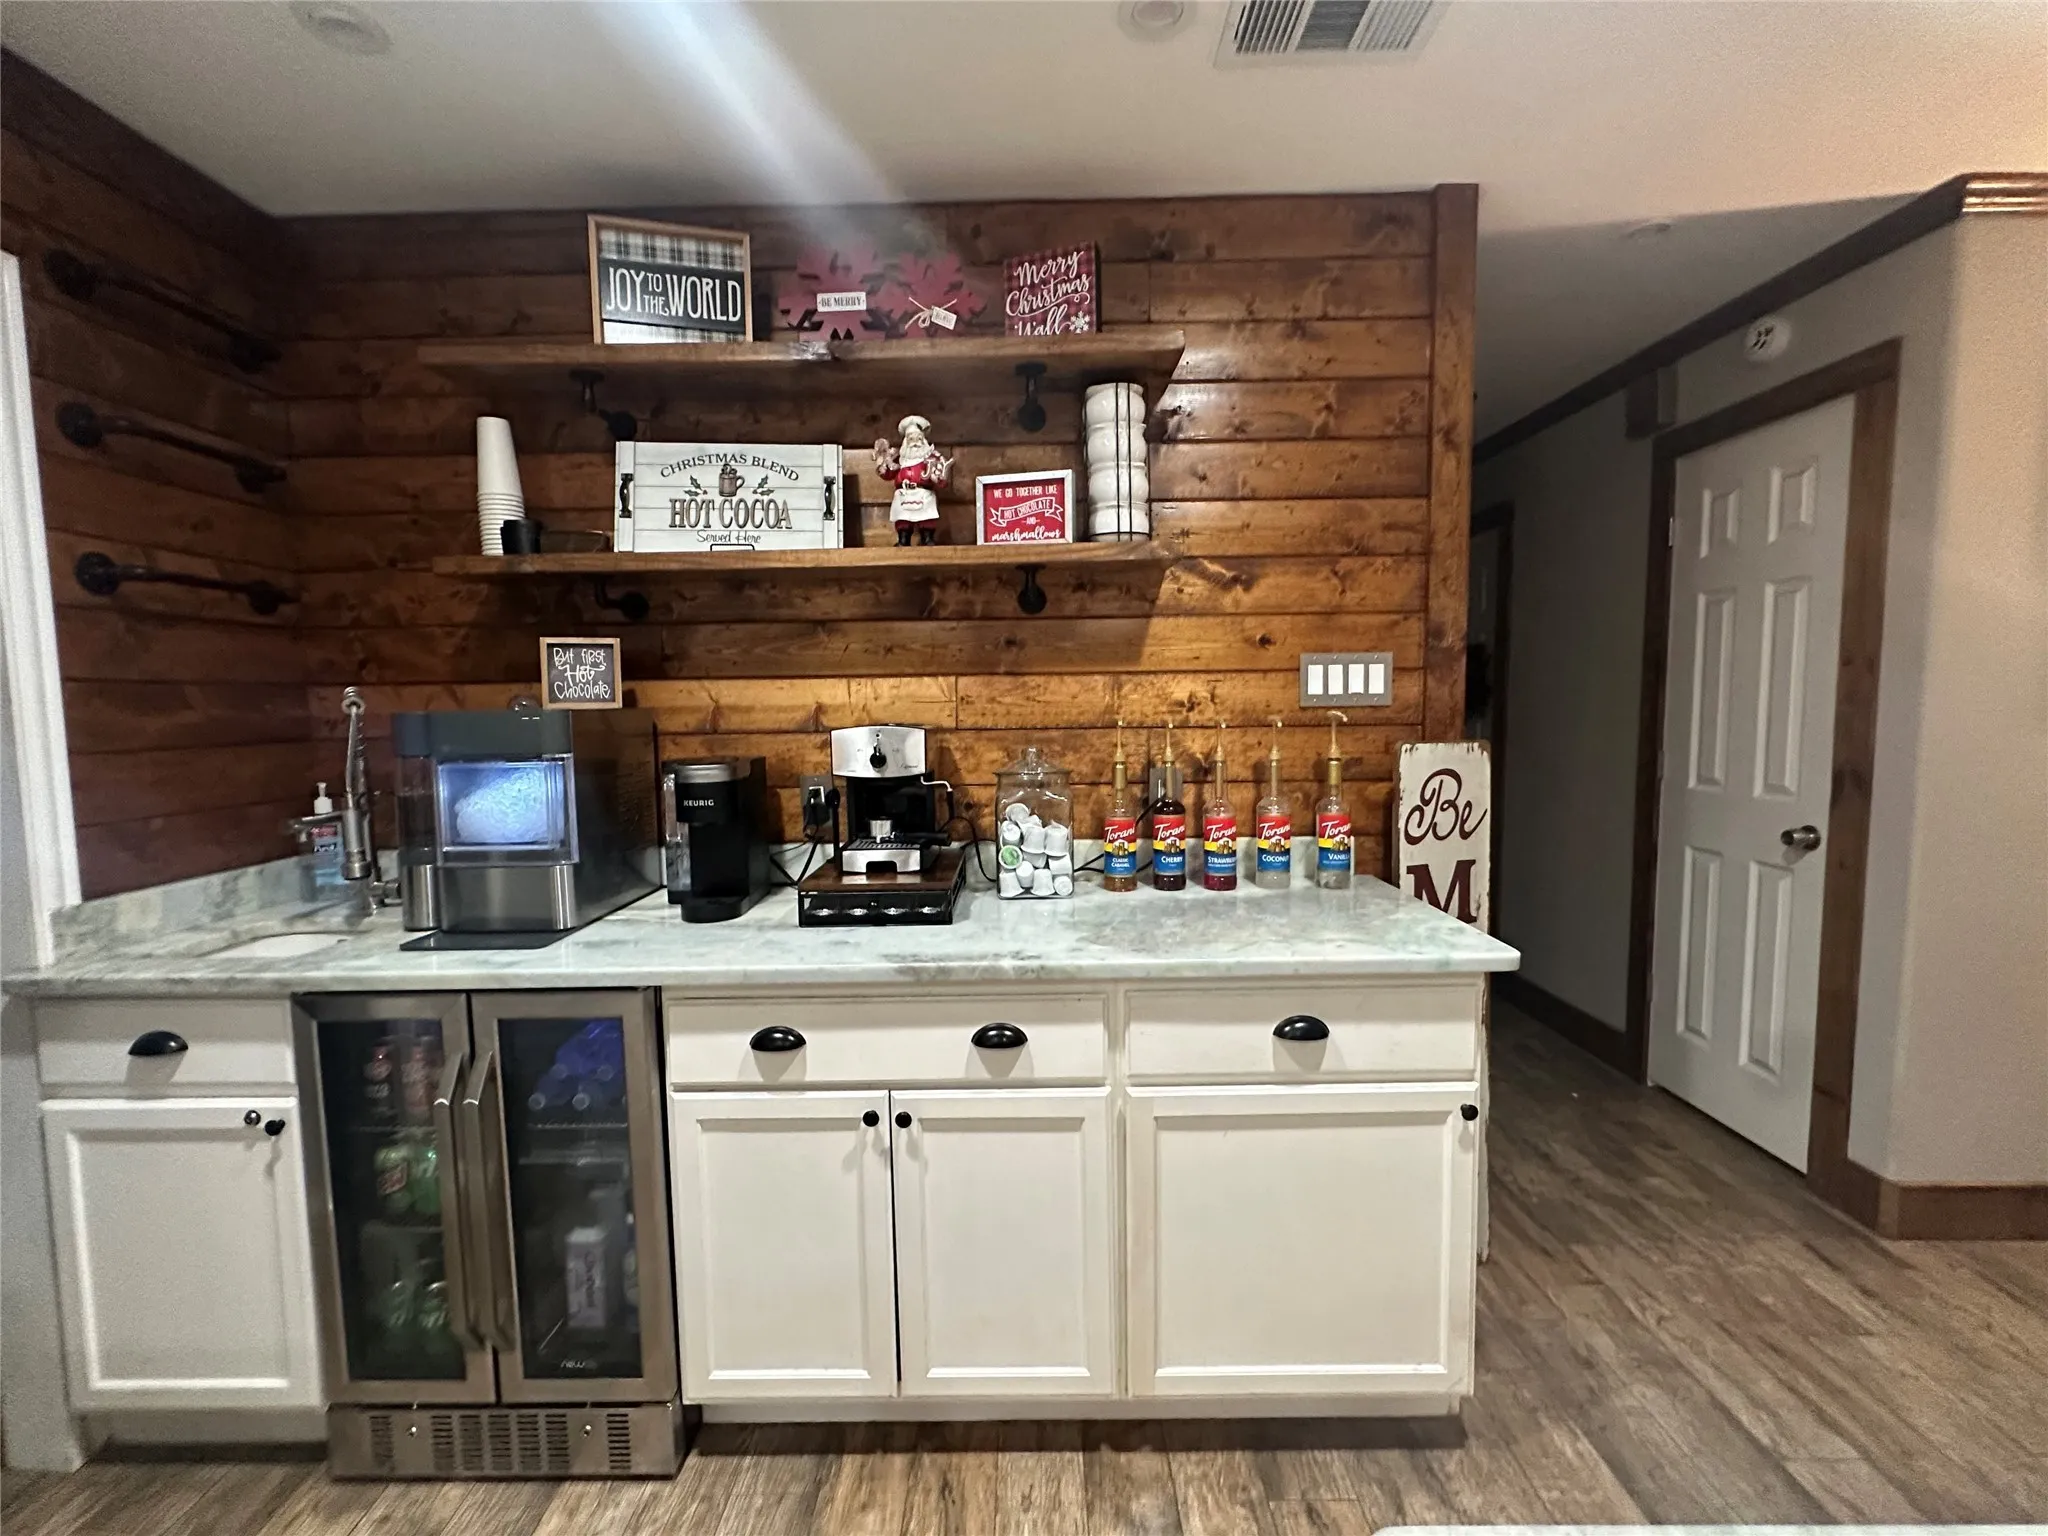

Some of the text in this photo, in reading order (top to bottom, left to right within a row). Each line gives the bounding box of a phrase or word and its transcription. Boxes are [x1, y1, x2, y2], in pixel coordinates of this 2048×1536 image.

[1013, 251, 1084, 287] Merry
[605, 267, 741, 322] JOY TO THE WORLD
[821, 295, 861, 307] BE MERRY
[1006, 273, 1092, 317] Christmas
[660, 453, 800, 482] CHRISTMAS BLEND
[921, 456, 953, 478] JY
[993, 485, 1058, 499] WE GO TOGETHER LIKE
[668, 497, 793, 530] HOT COCOA
[1003, 499, 1051, 520] HOT CHOCOLATE
[1026, 517, 1037, 525] AND
[696, 529, 762, 545] Served Here
[991, 525, 1062, 541] marshmallows
[553, 647, 575, 667] But
[558, 664, 606, 686] Hot
[554, 680, 611, 699] Chocolate
[683, 799, 715, 807] KEURIG
[1404, 768, 1488, 846] Be
[1104, 823, 1135, 844] Torani
[1155, 822, 1185, 842] Toran
[1161, 855, 1183, 863] CHERRY
